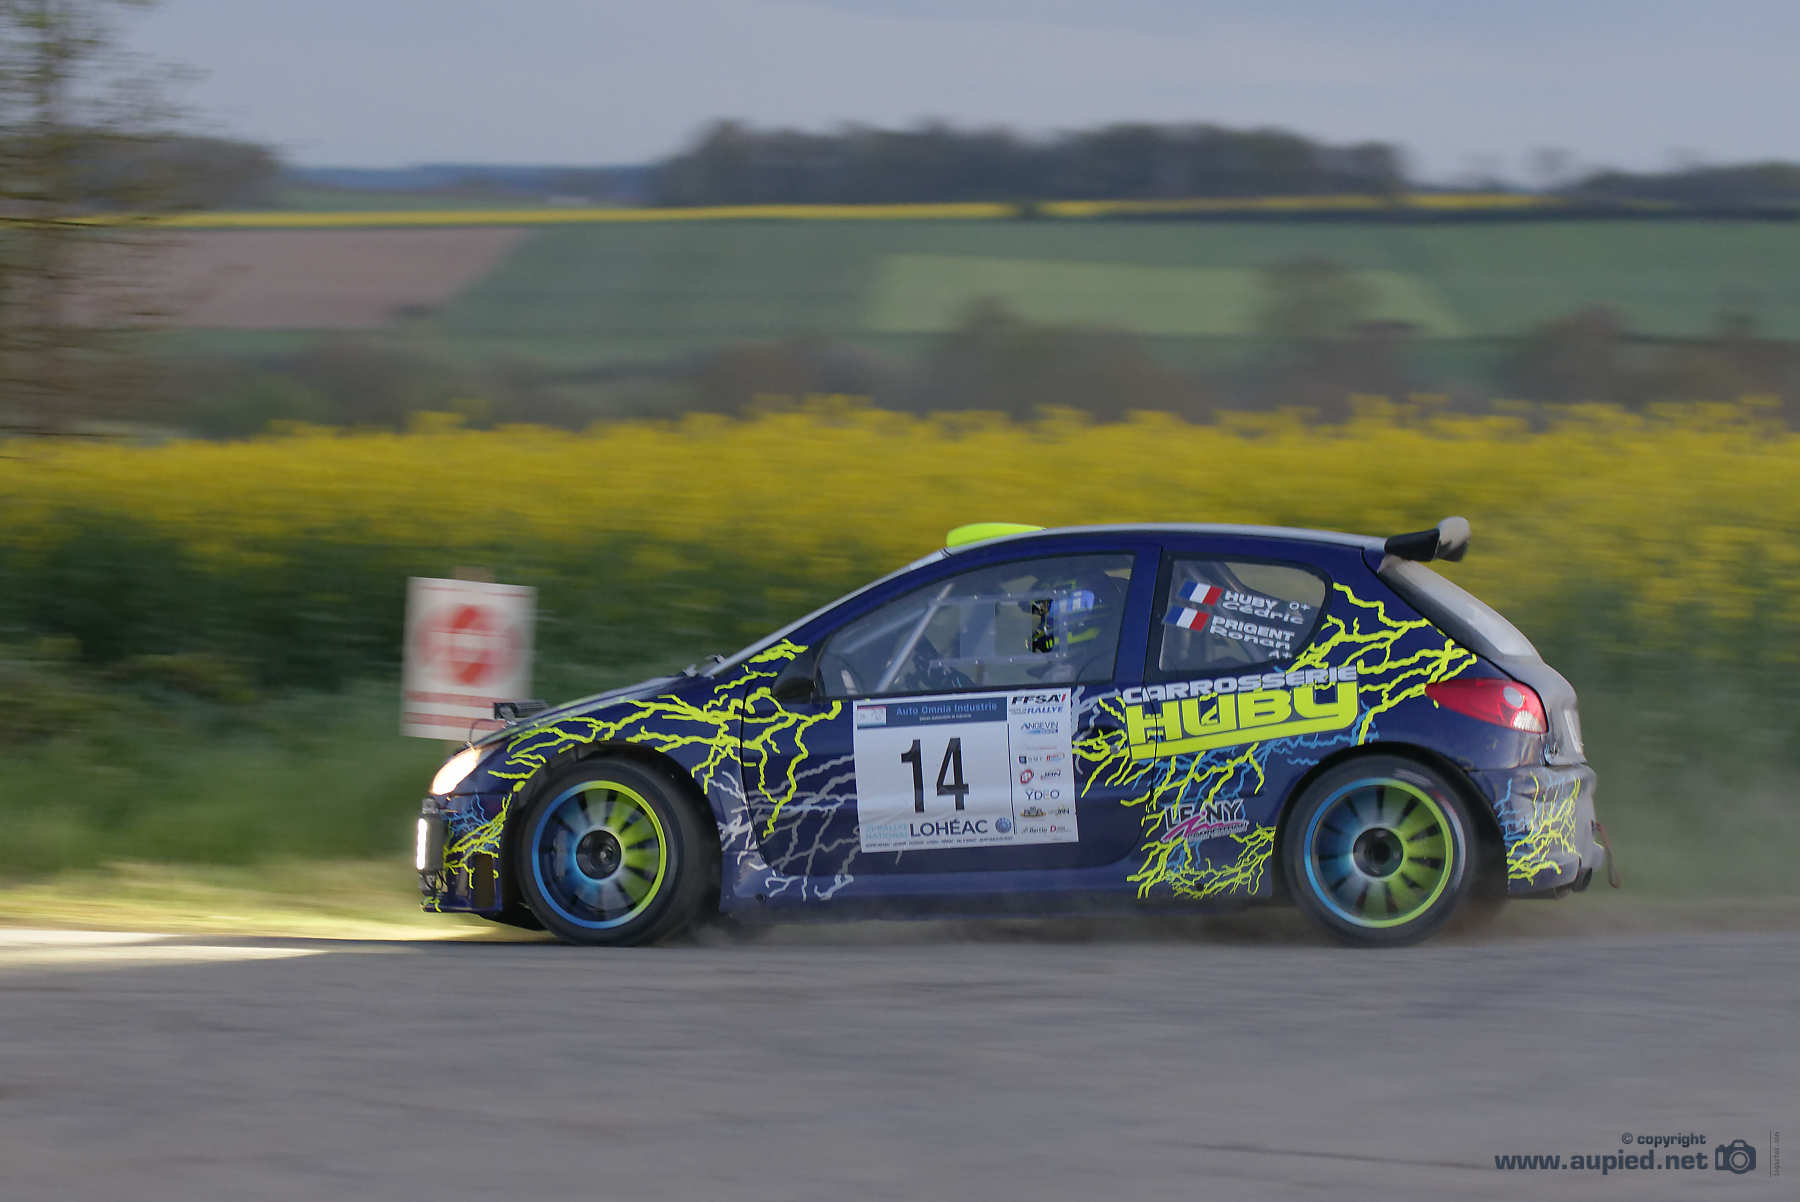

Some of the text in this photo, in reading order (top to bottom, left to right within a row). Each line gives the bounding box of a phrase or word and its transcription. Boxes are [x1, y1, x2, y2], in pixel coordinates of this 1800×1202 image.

[1224, 590, 1279, 611] HUBY
[1209, 625, 1291, 650] Ronan
[1211, 615, 1296, 641] PRIGENT
[1122, 665, 1358, 704] CARROSSERIE
[896, 706, 919, 716] Auto
[954, 701, 997, 713] Industrie
[1126, 681, 1358, 760] HUBY
[901, 736, 970, 814] 14
[910, 819, 988, 837] LOHÉAC
